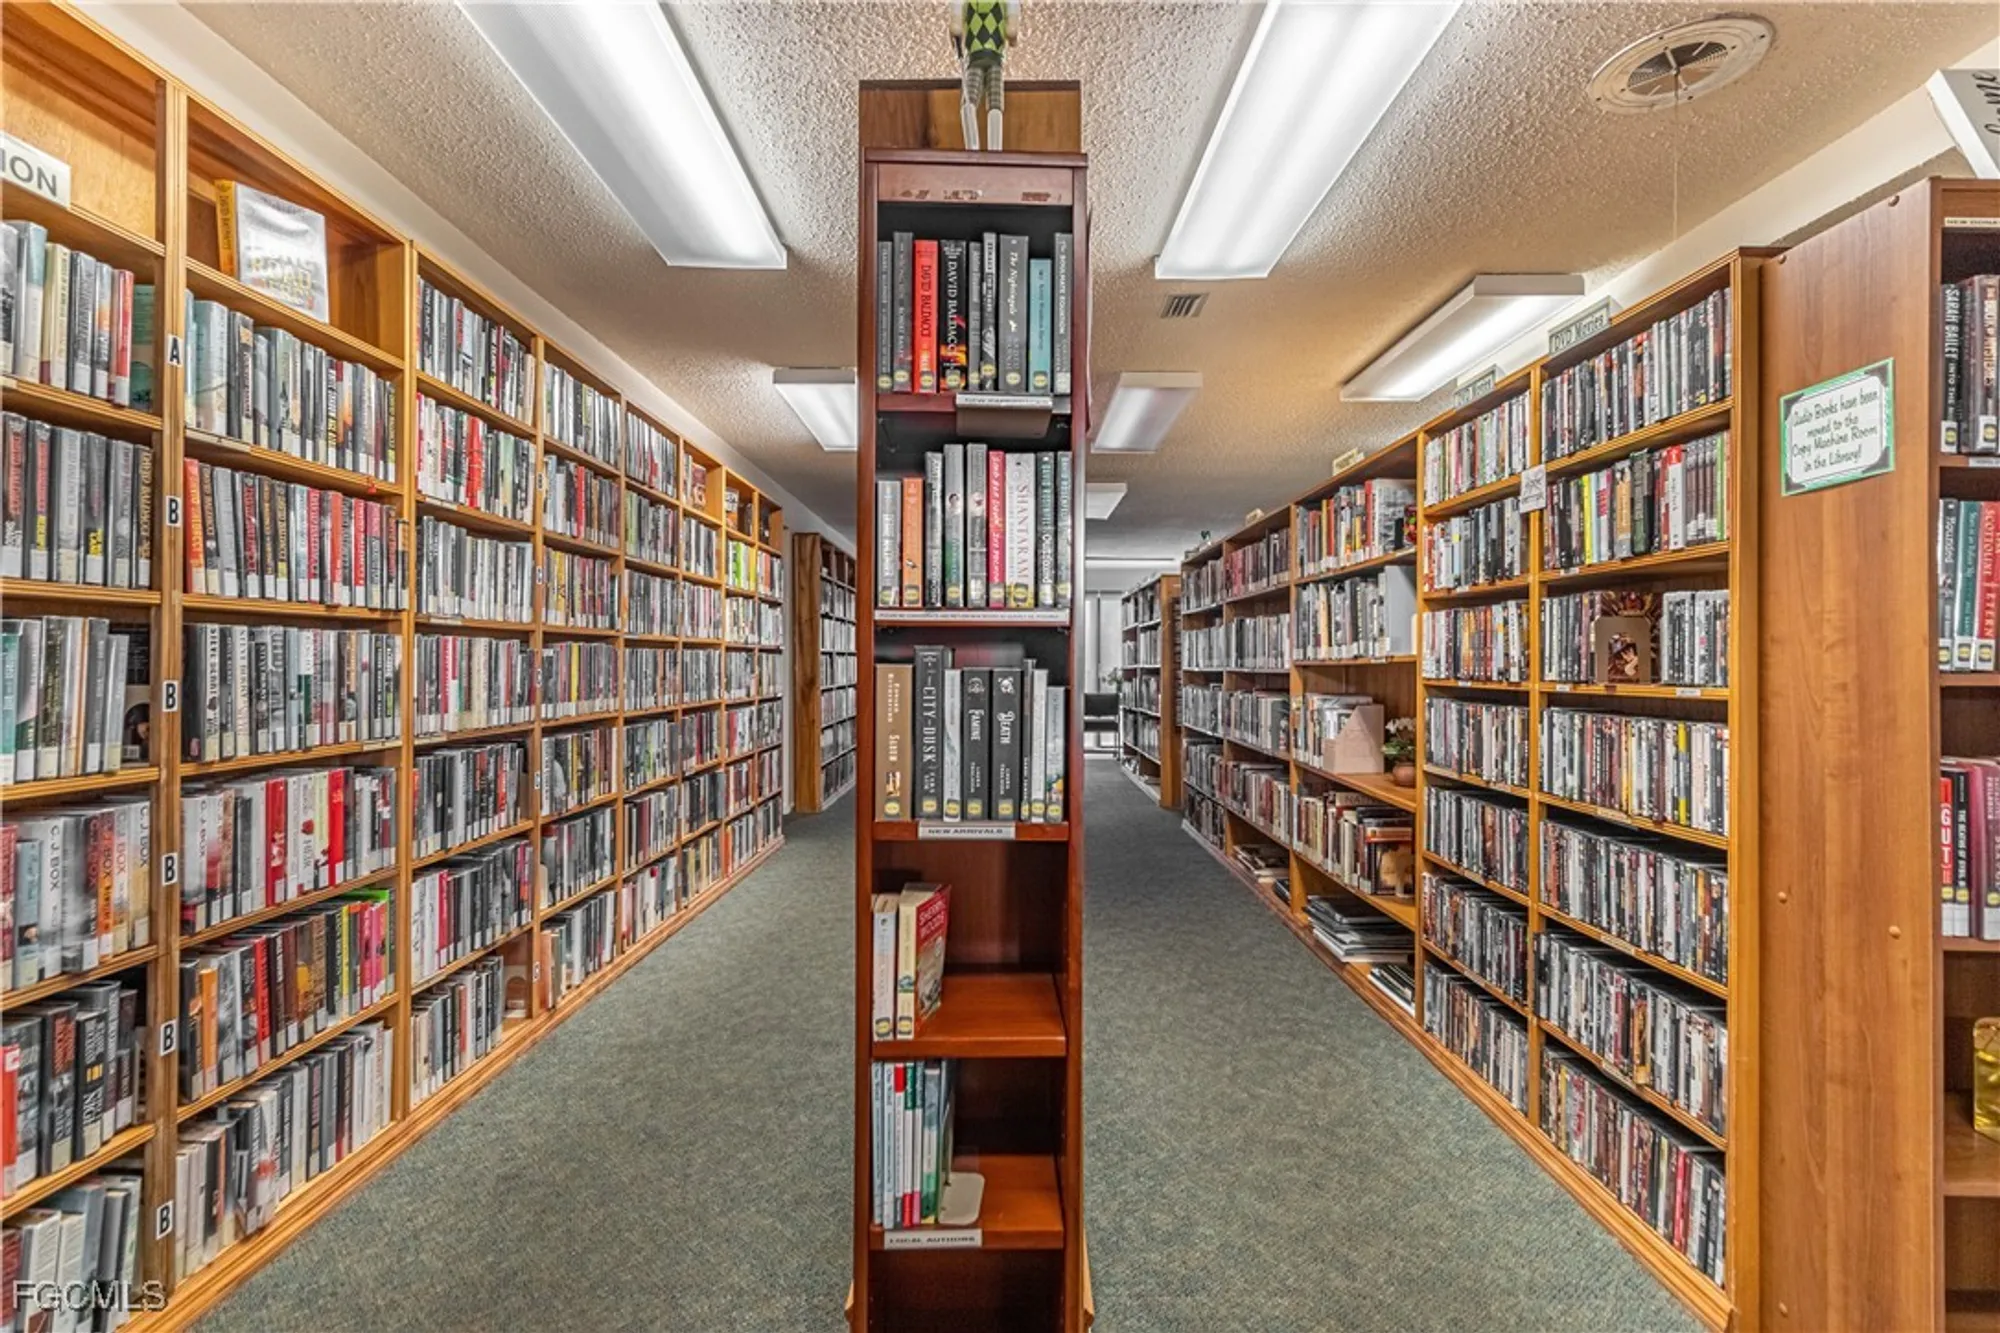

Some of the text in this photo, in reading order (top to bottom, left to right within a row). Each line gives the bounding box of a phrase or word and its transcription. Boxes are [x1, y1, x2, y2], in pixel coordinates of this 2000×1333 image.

[921, 264, 932, 337] DAVID BALDACCI
[948, 261, 959, 355] DAVID BALDACCI
[1945, 290, 1960, 322] SARAH
[170, 337, 180, 364] A
[1945, 325, 1960, 359] BAILEY
[1814, 399, 1838, 419] Books
[1840, 394, 1858, 411] have
[1860, 388, 1878, 405] been
[1807, 412, 1859, 437] moved to the
[1792, 426, 1878, 458] Copy Machine Room
[1814, 455, 1827, 468] the
[1829, 443, 1861, 465] Library!
[168, 498, 179, 524] B
[1017, 484, 1029, 579] SHANTARAM
[1984, 509, 1997, 637] SCOTTOLINE ETERN
[166, 683, 176, 709] B
[922, 686, 938, 763] CITY DUSK
[968, 709, 985, 742] FAMINE
[997, 711, 1016, 745] DEATH
[140, 836, 149, 868] BOX
[50, 856, 60, 892] BOX
[164, 855, 175, 882] B
[163, 1023, 174, 1051] B
[160, 1204, 171, 1235] B
